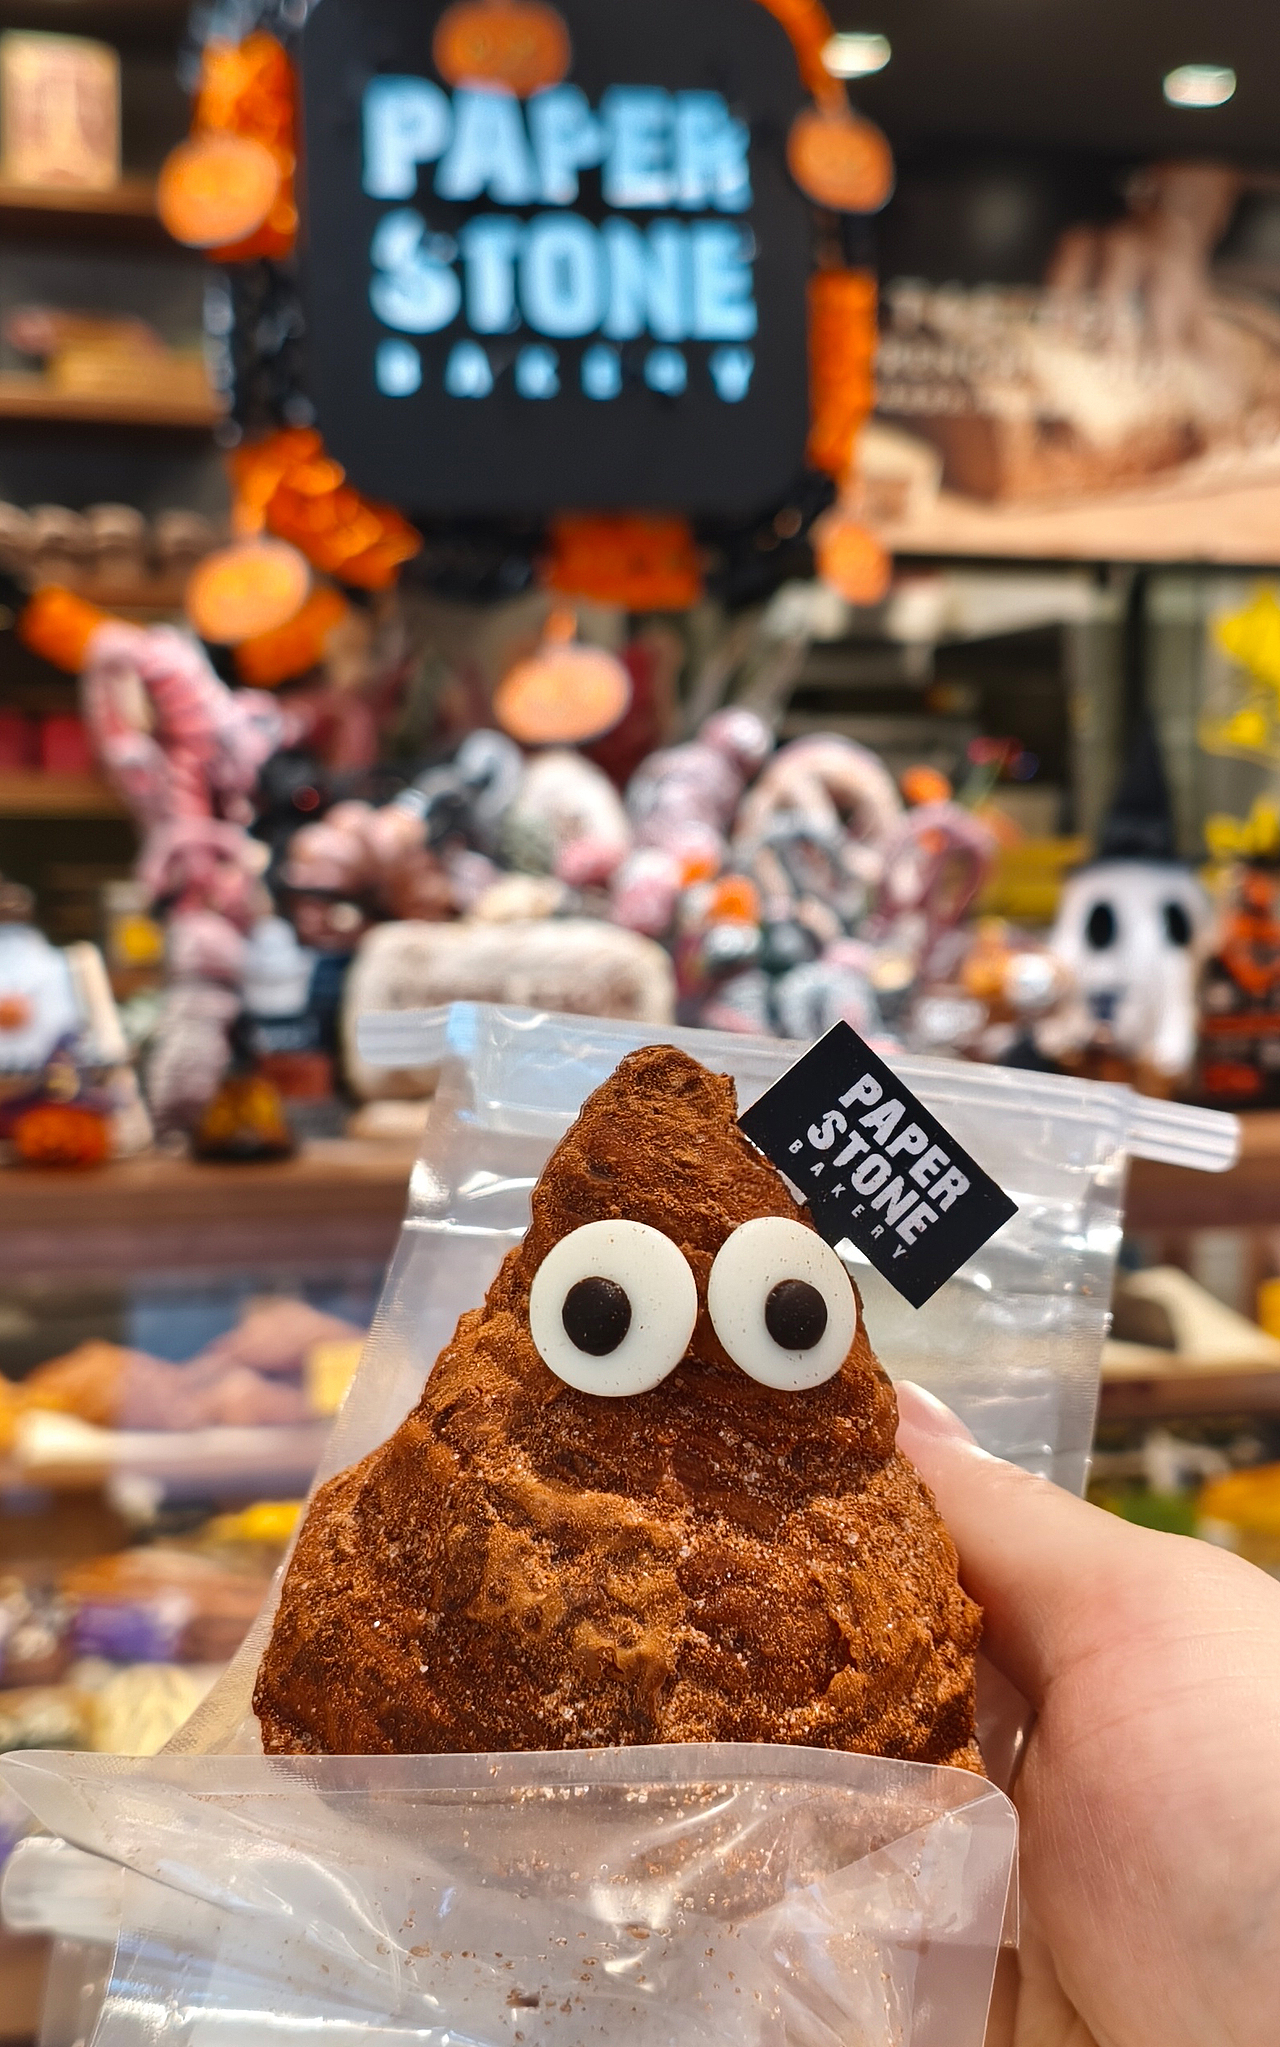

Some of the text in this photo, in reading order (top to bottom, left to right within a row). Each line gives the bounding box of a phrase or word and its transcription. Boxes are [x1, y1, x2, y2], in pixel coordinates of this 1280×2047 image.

[363, 75, 751, 212] PAPER
[370, 208, 757, 341] STONE
[788, 1140, 907, 1259] BAKERY
[807, 1111, 939, 1246] STONE
[838, 1073, 970, 1212] PAPER
